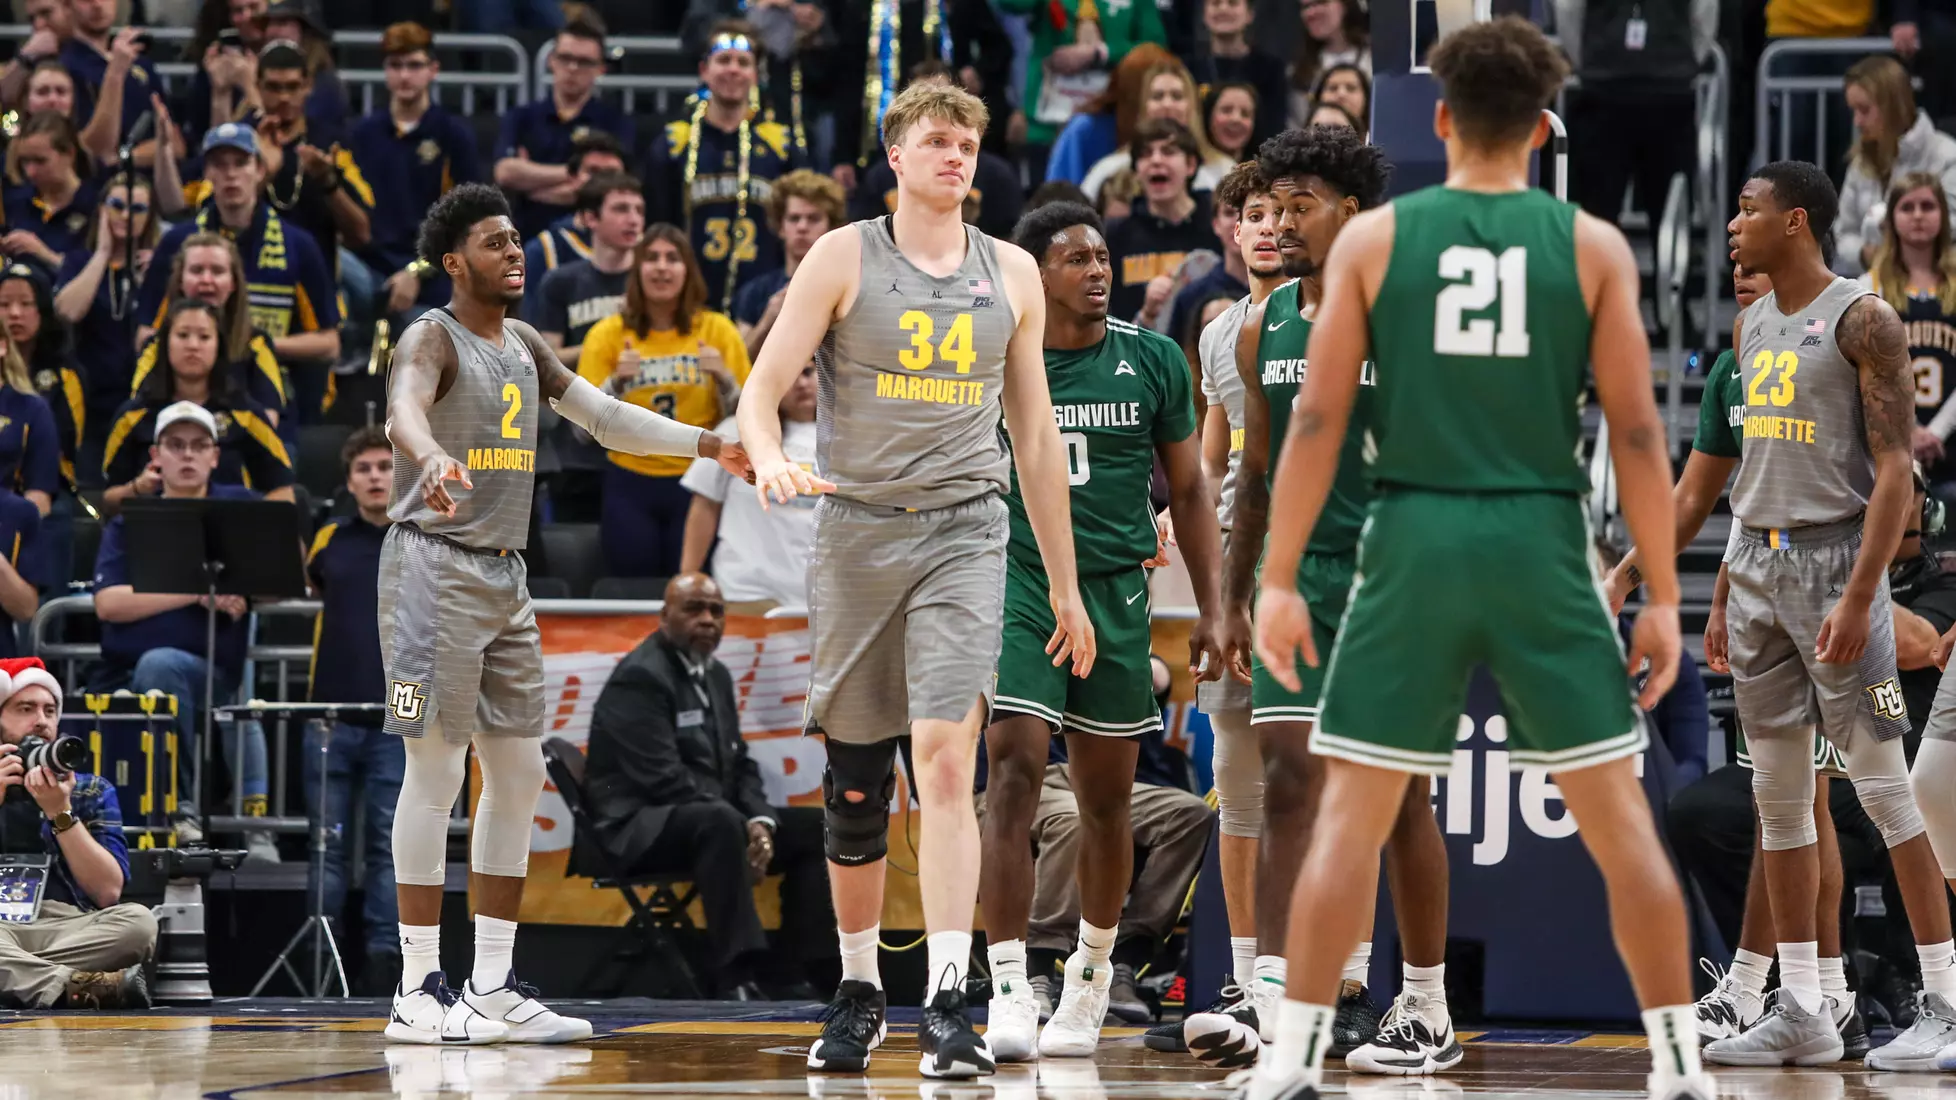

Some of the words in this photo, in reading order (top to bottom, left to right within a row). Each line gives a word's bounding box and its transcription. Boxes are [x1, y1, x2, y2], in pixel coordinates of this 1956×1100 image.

[703, 218, 758, 261] 32
[932, 290, 943, 299] AL
[1434, 245, 1529, 357] 21
[898, 310, 977, 374] 34
[876, 373, 984, 405] MARQUETTE
[1747, 349, 1799, 407] 23
[1911, 356, 1943, 407] 3
[501, 383, 522, 439] 2
[389, 680, 426, 721] MU
[1866, 677, 1906, 720] MU
